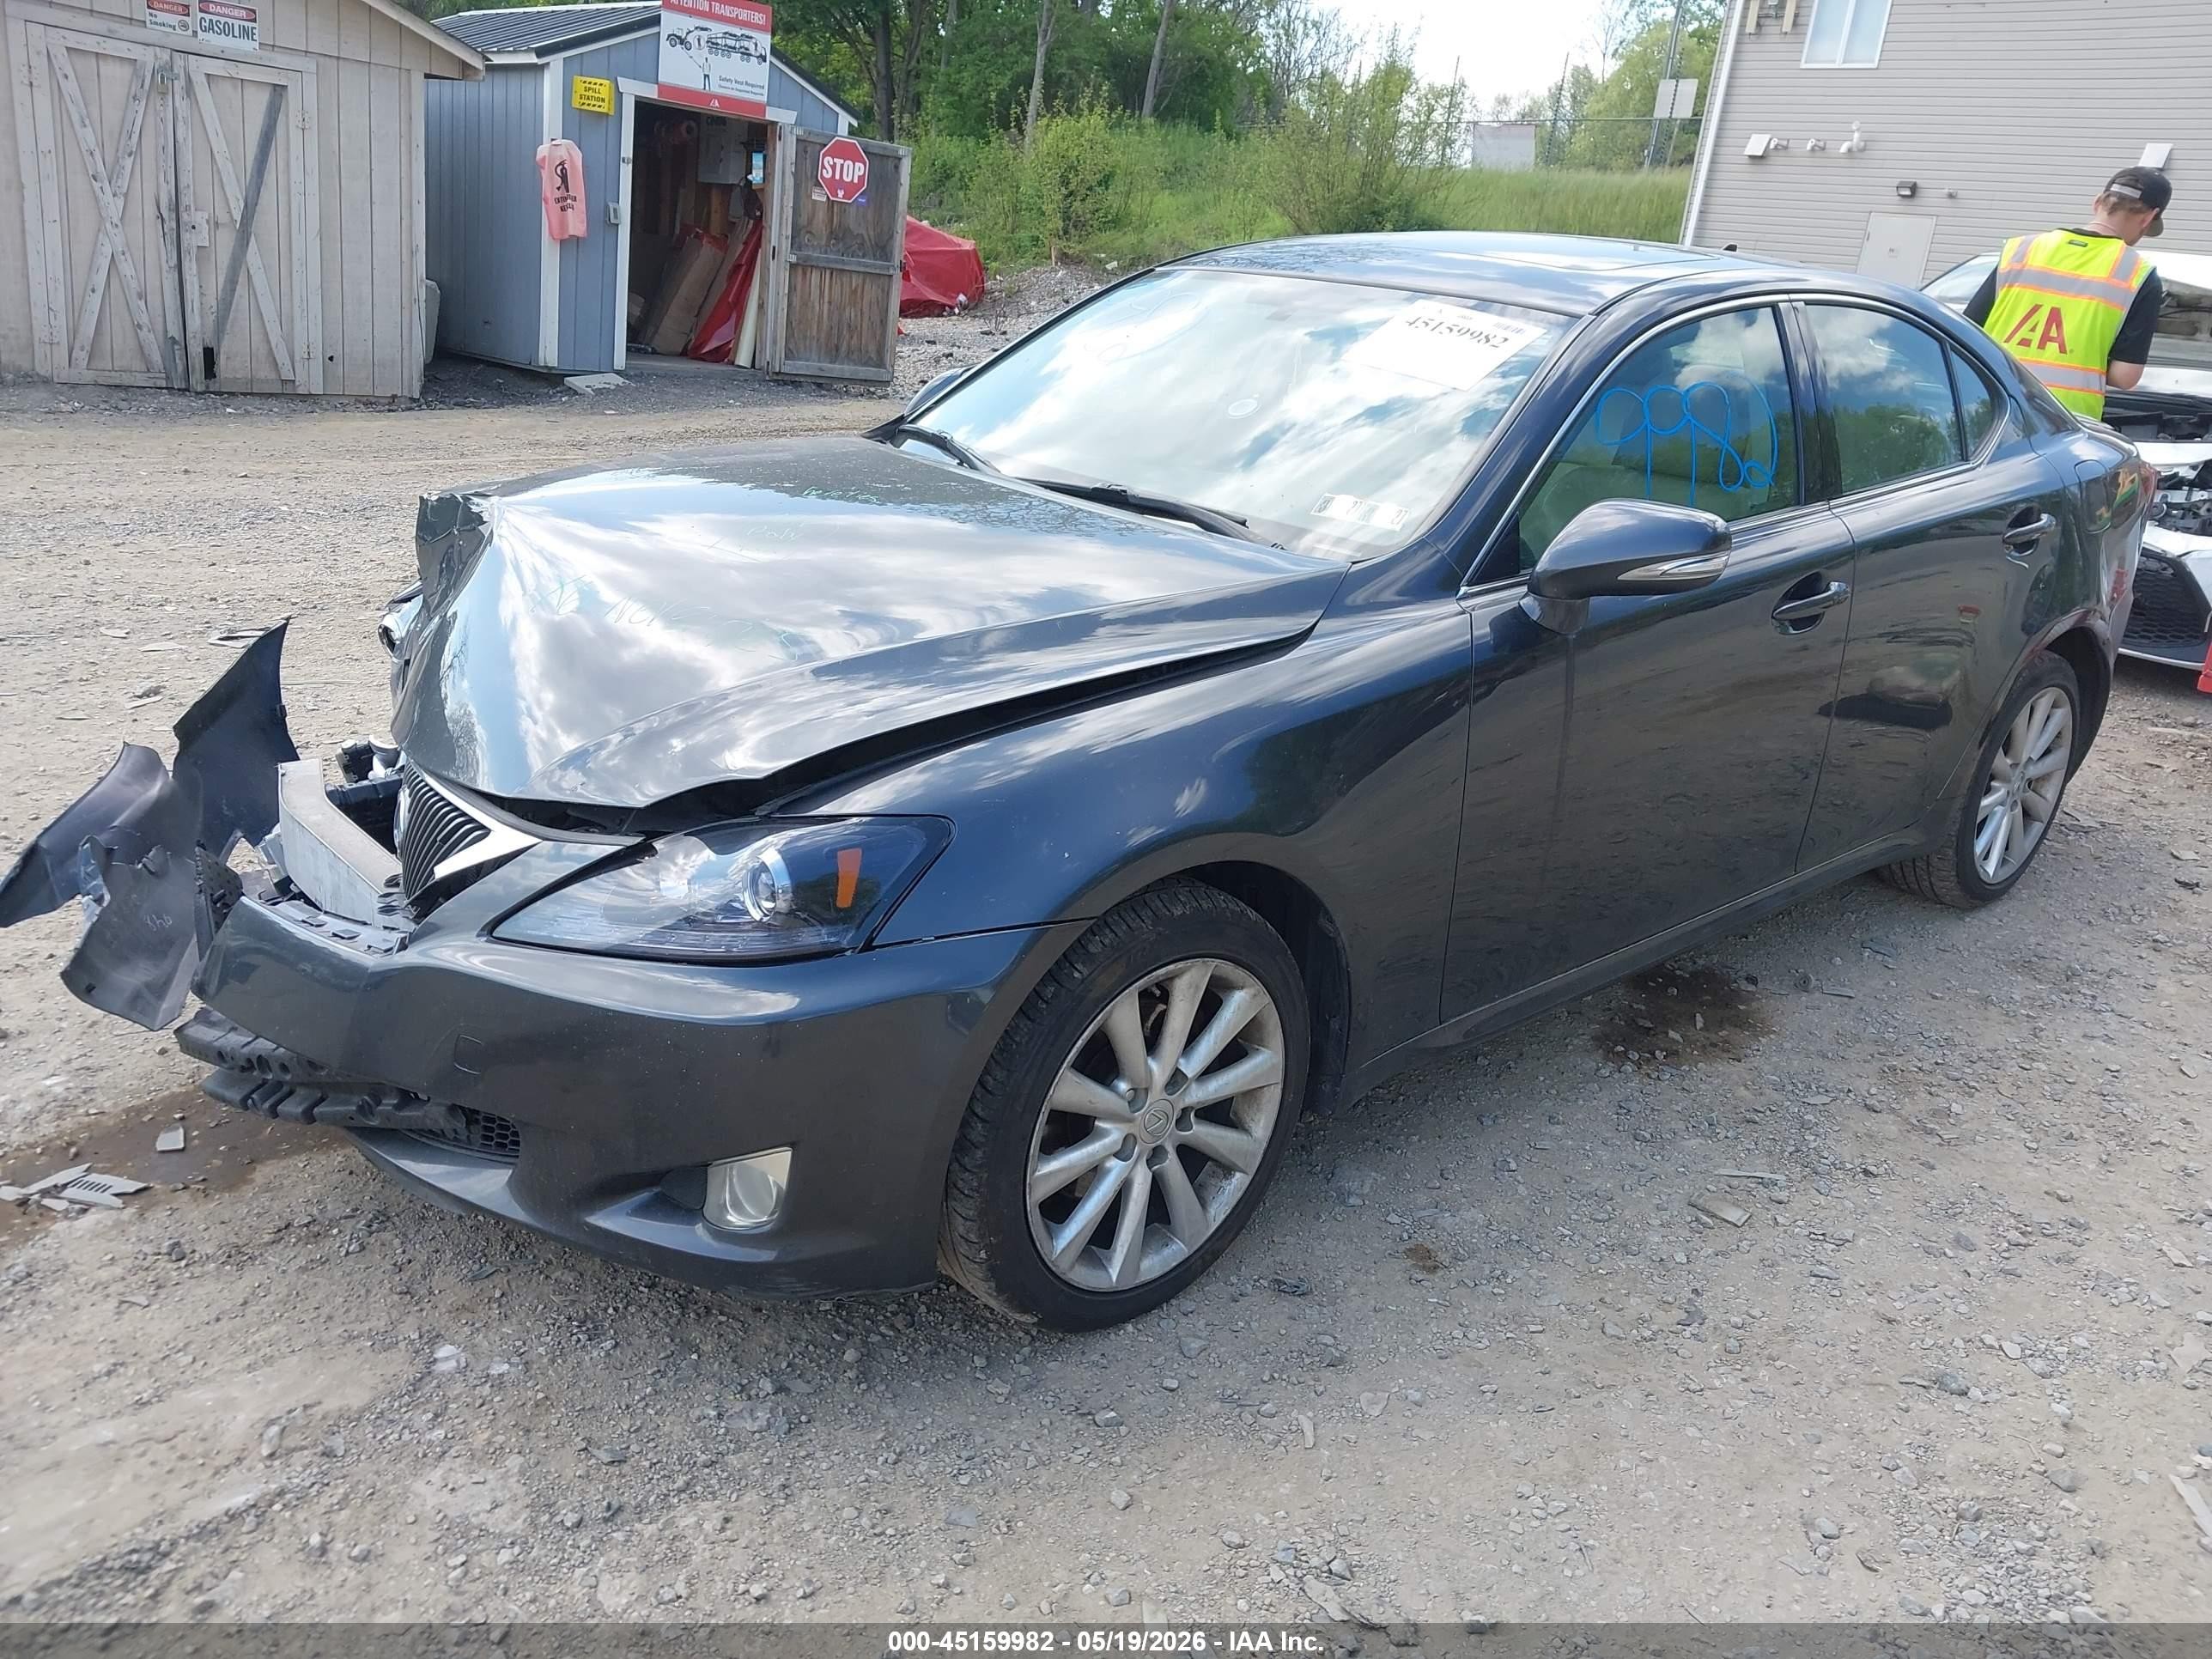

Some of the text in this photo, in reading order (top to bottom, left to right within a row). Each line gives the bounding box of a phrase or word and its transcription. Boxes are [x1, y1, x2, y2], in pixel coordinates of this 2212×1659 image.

[154, 2, 183, 13] DANGER
[209, 3, 246, 18] DANGER
[711, 2, 766, 25] TRANSPORTERS!
[149, 19, 177, 31] Smoking
[199, 16, 257, 41] GASOLINE
[584, 86, 601, 94] SPILL
[579, 94, 605, 104] STATION
[822, 156, 865, 184] STOP
[1405, 316, 1509, 348] 45159982
